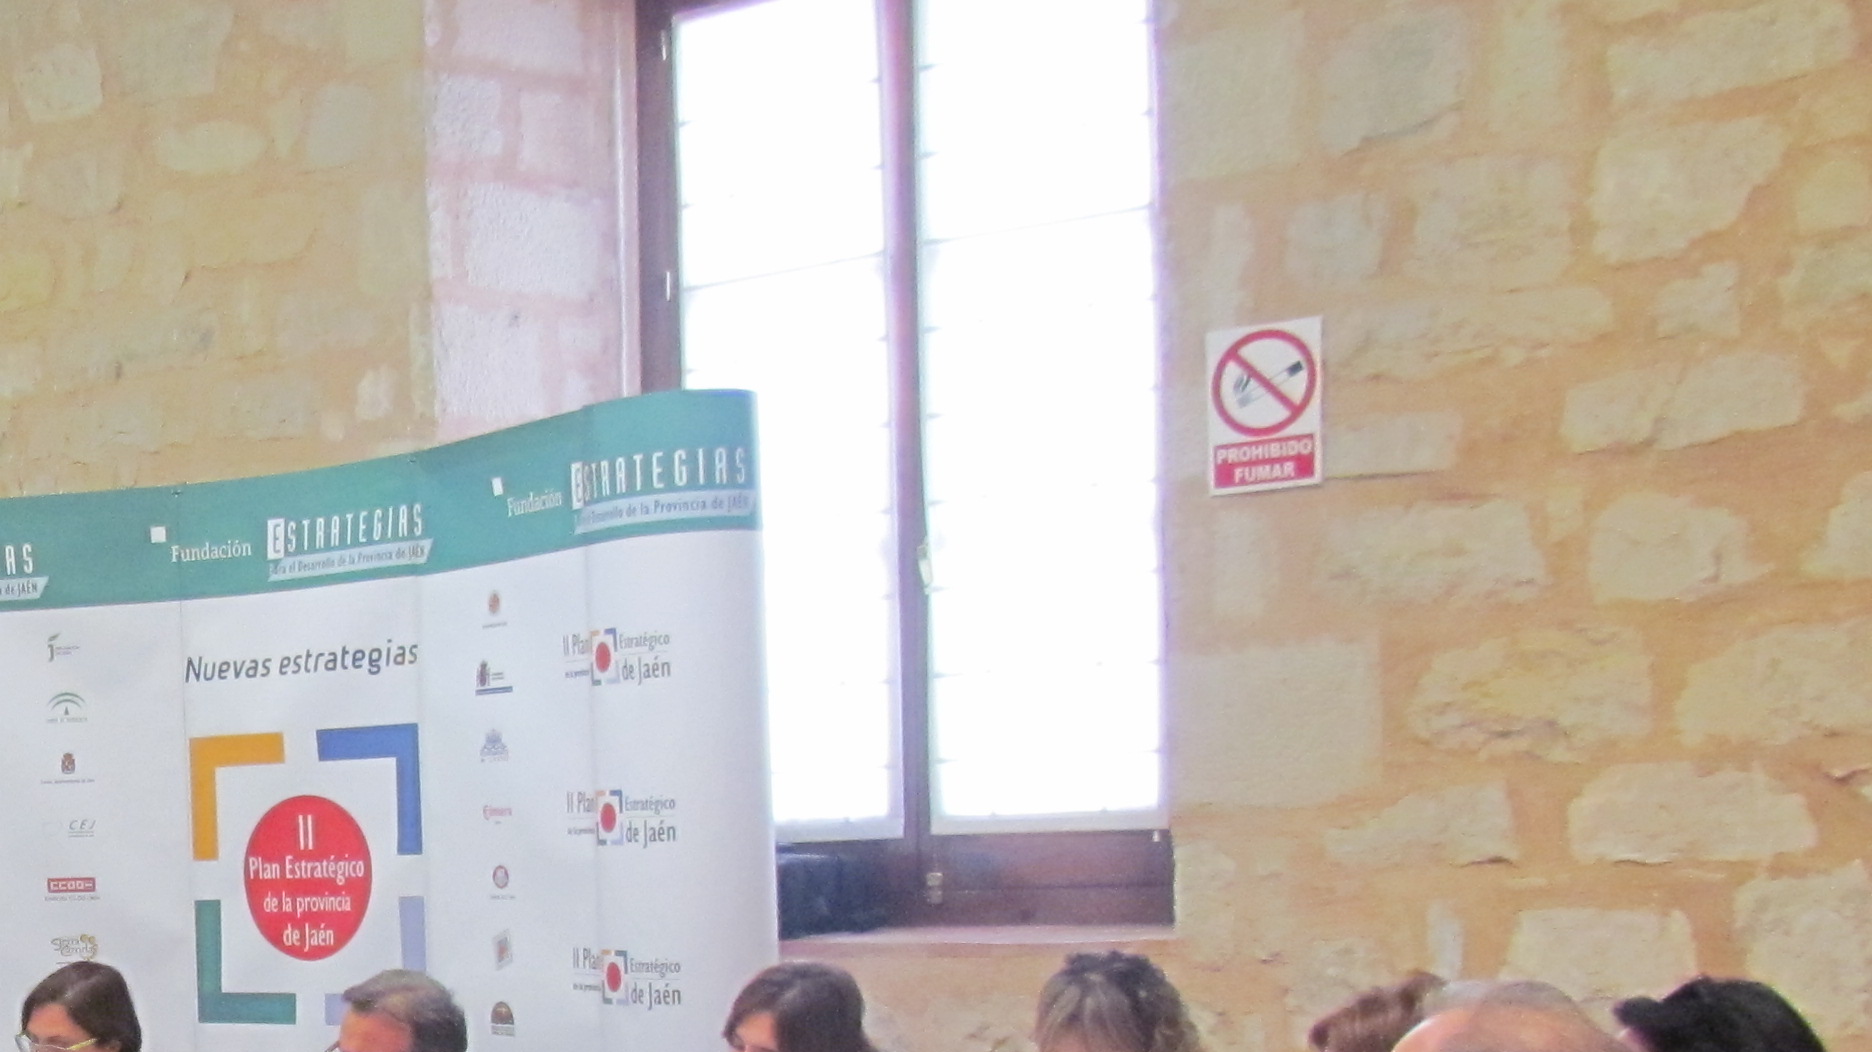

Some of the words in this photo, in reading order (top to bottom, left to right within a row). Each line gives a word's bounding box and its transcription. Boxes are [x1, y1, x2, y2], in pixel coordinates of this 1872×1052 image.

[1216, 438, 1312, 464] PROHIBIDO
[507, 488, 562, 517] Fundación
[571, 448, 745, 510] ESTRATEGIAS
[1234, 461, 1295, 483] FUMAR
[653, 499, 706, 513] Provincia
[170, 540, 251, 563] Fundación
[267, 504, 423, 559] ESTRATEGIAS
[5, 583, 15, 595] de
[619, 630, 670, 651] Estratégico
[185, 656, 272, 683] Nuevas
[279, 639, 418, 676] estrategias
[622, 658, 635, 681] de
[638, 655, 671, 686] Jaén
[625, 795, 675, 815] Estratégico
[298, 814, 313, 850] II
[626, 821, 639, 843] de
[643, 820, 676, 848] Jaén
[249, 857, 280, 879] Plan
[285, 853, 364, 885] Estratégico
[264, 891, 278, 912] de
[282, 891, 292, 912] la
[296, 891, 351, 918] provincia
[283, 923, 300, 946] de
[304, 923, 334, 952] Jaén
[630, 958, 680, 978] Estratégico
[631, 982, 644, 1004] de
[648, 982, 681, 1010] Jaén
